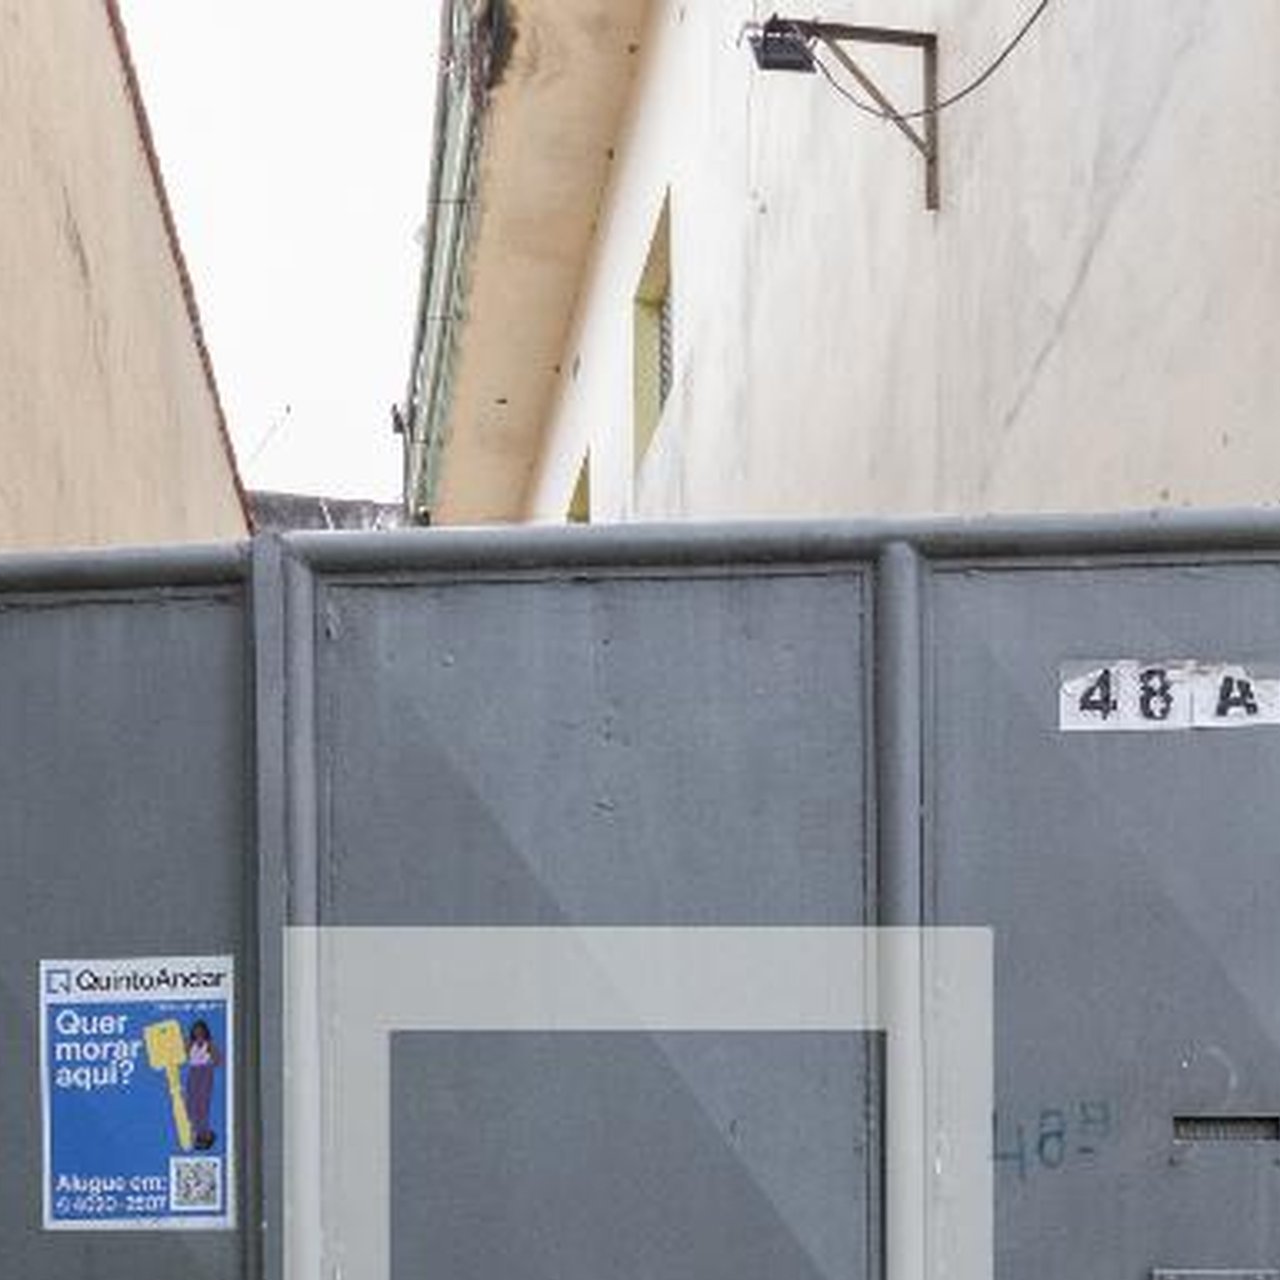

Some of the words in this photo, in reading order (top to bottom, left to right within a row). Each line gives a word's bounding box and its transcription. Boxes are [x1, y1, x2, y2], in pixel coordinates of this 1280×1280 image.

[1079, 669, 1174, 721] 48
[1216, 676, 1258, 717] A
[75, 968, 226, 992] QuintoAndar
[55, 1009, 127, 1035] Quer
[55, 1039, 143, 1061] morar
[55, 1061, 134, 1089] aqui?
